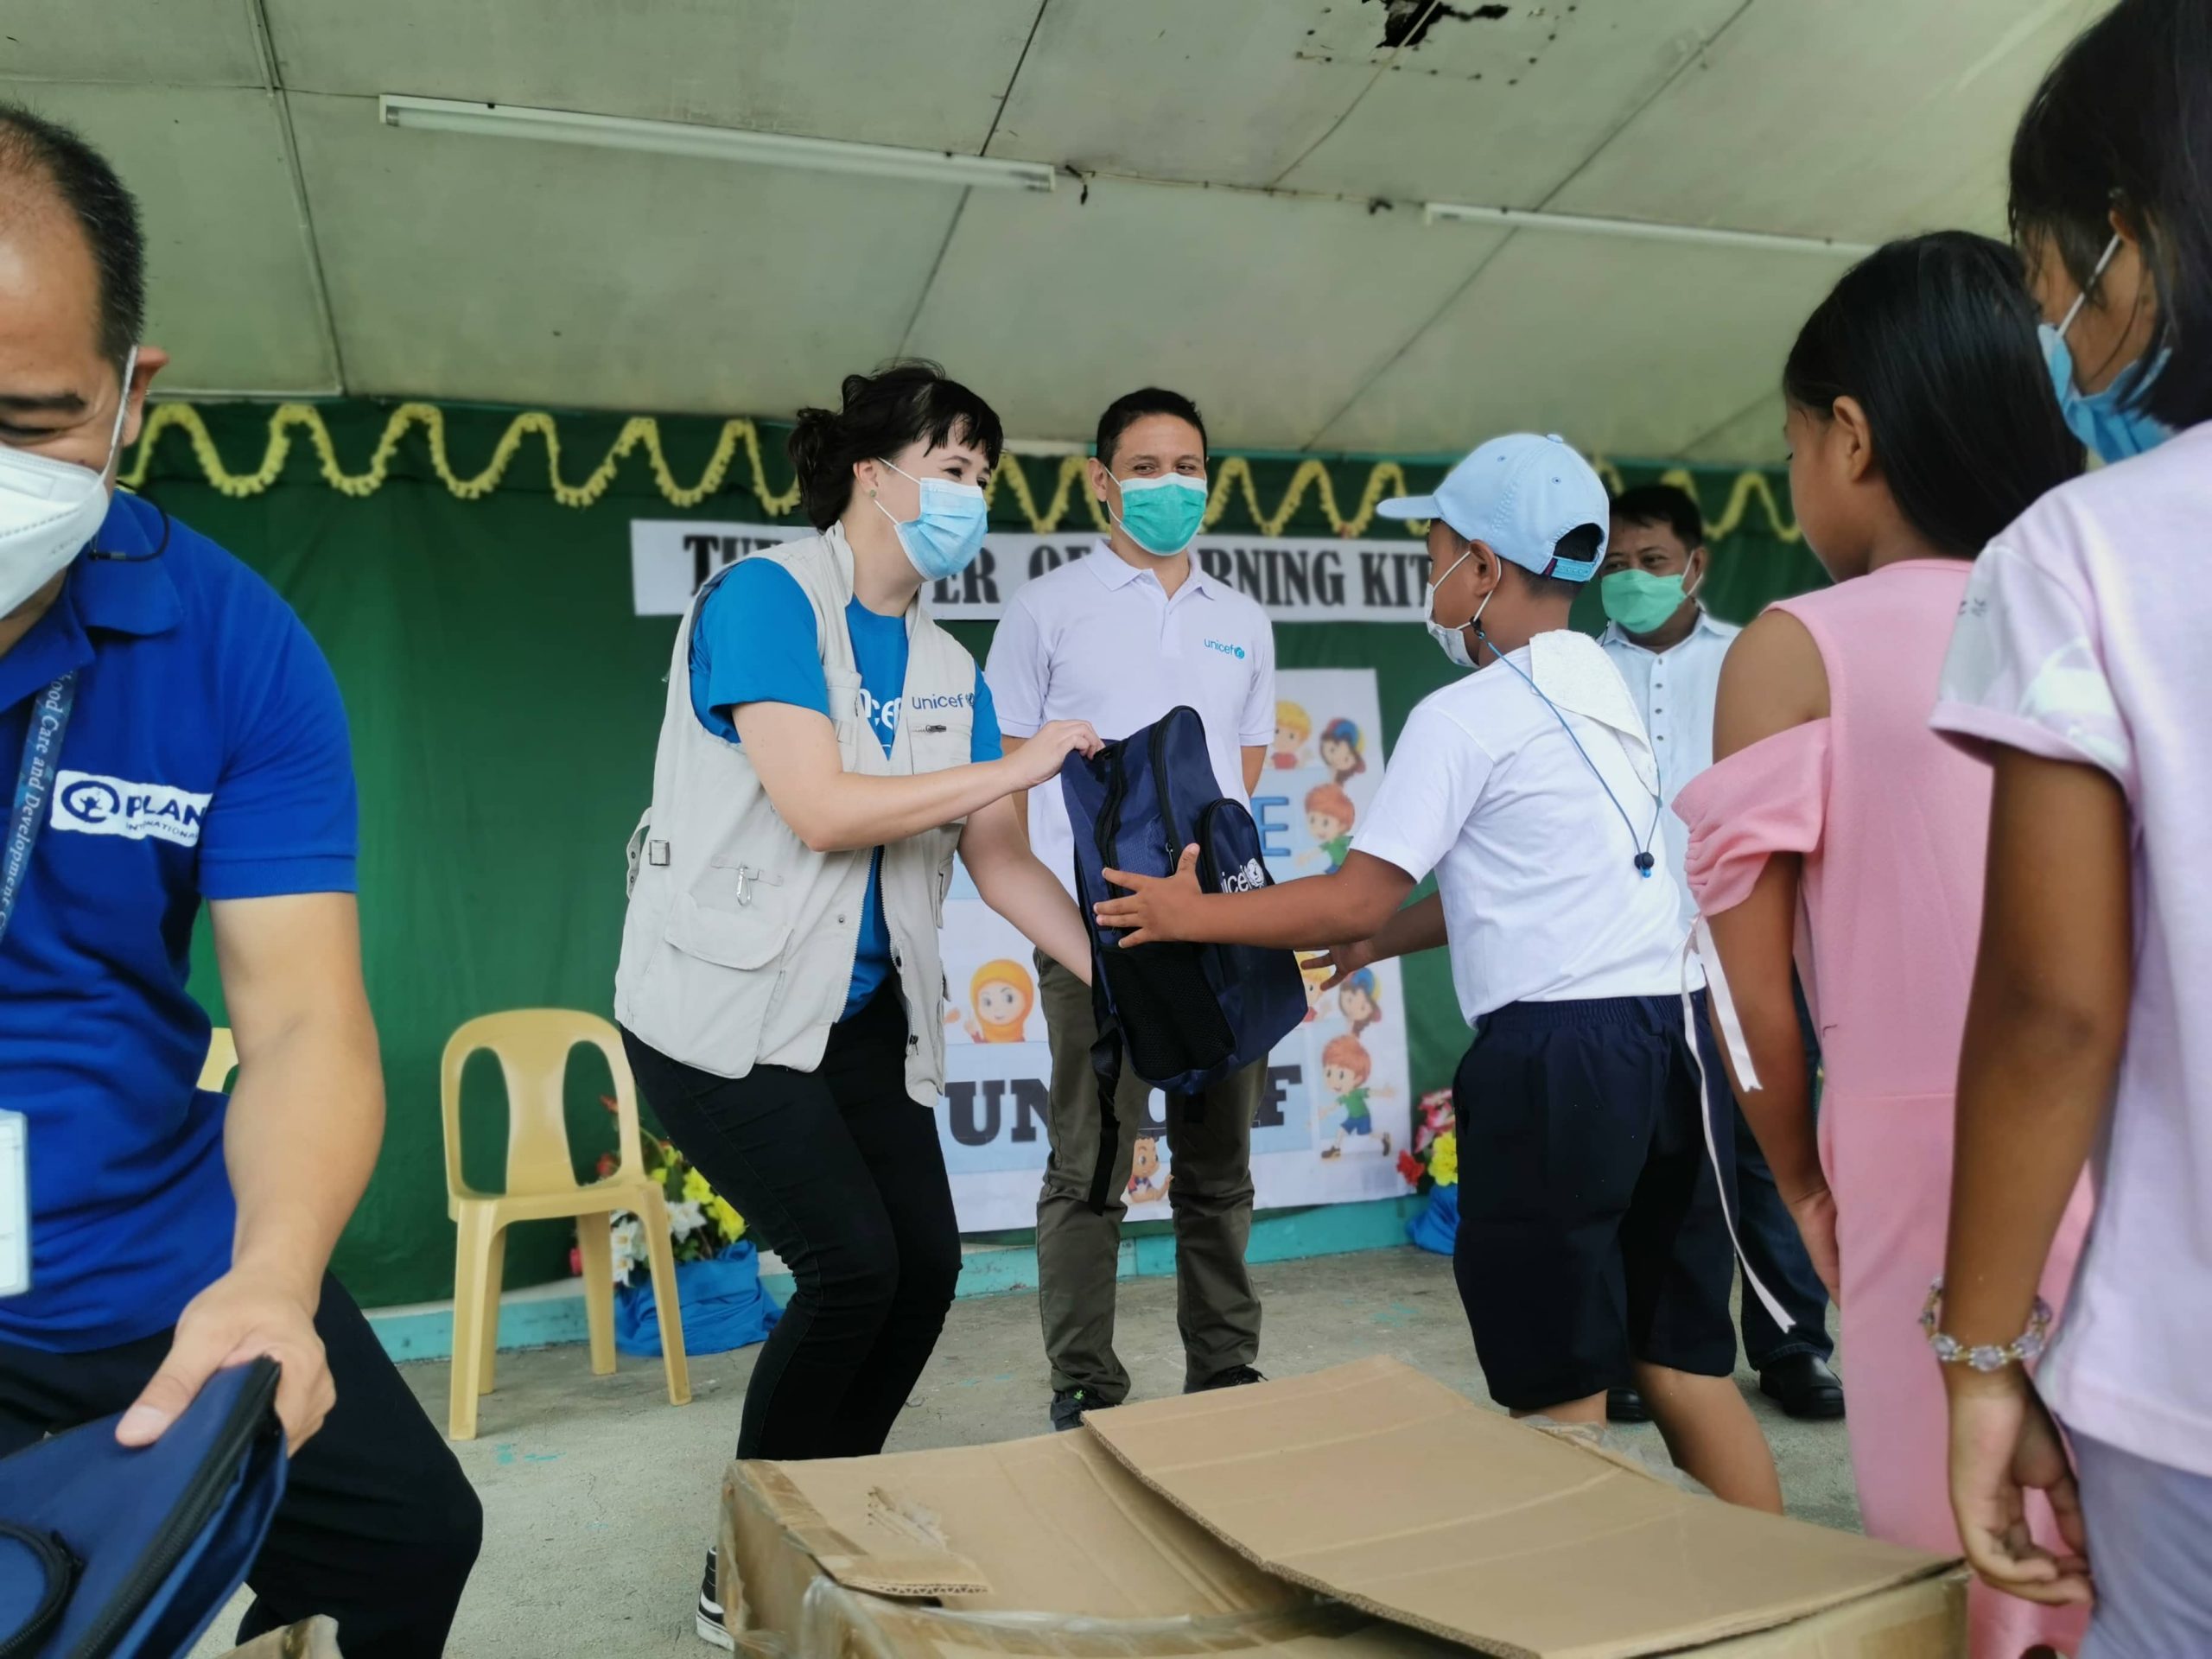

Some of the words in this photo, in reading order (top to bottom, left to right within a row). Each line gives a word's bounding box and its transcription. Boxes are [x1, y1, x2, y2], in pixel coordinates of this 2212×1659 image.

[1198, 549, 1345, 607] RNING
[1204, 639, 1234, 656] unicef
[912, 693, 964, 710] unicef
[36, 715, 60, 753] Care
[28, 757, 45, 791] and
[126, 795, 207, 826] PLAN
[3, 791, 41, 907] Development
